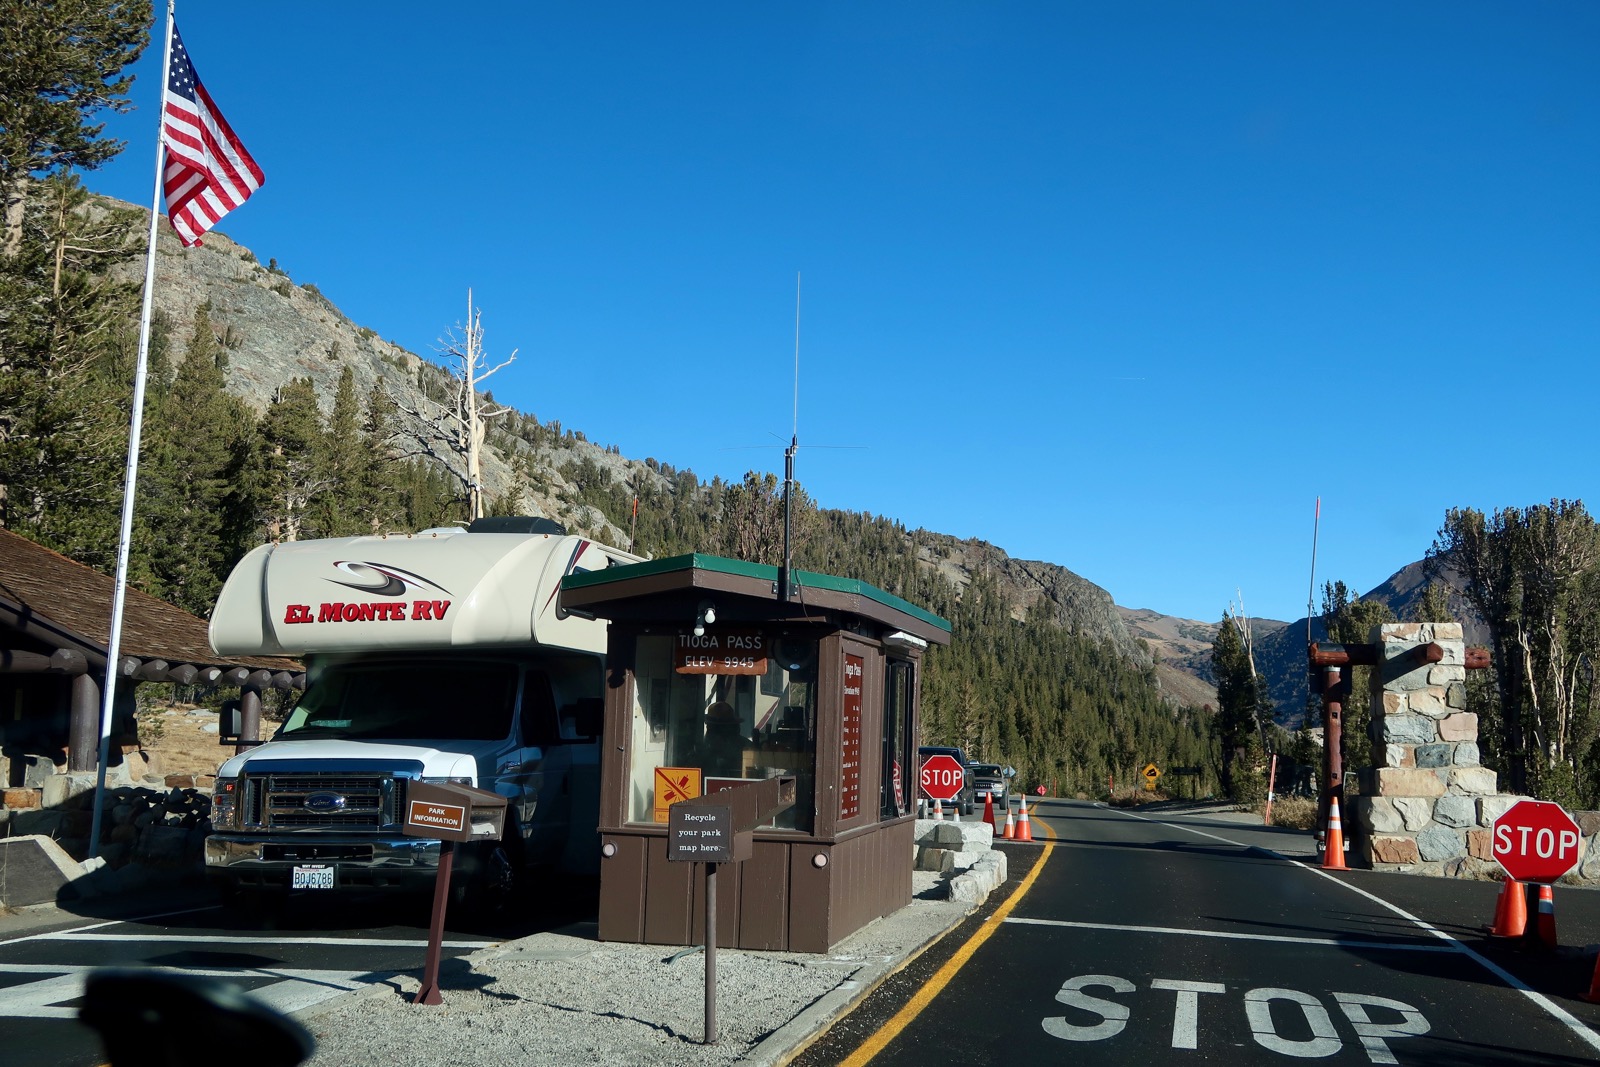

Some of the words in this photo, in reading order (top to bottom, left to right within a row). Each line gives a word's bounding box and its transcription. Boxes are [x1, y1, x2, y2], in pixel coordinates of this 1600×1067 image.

[284, 604, 313, 624] EL
[318, 602, 406, 622] MONTE
[411, 600, 451, 620] RV
[679, 634, 719, 648] TIOGA
[727, 635, 762, 649] PASS
[685, 656, 716, 667] ELEV.
[724, 656, 754, 668] 9945
[922, 769, 962, 786] STOP
[428, 807, 446, 815] PARK
[413, 814, 459, 826] INFORMATION
[684, 813, 716, 822] Recycle
[678, 830, 698, 838] your
[701, 829, 721, 838] park
[1494, 824, 1578, 860] STOP
[679, 845, 697, 853] map
[700, 844, 721, 852] here.
[1041, 974, 1431, 1065] STOP
